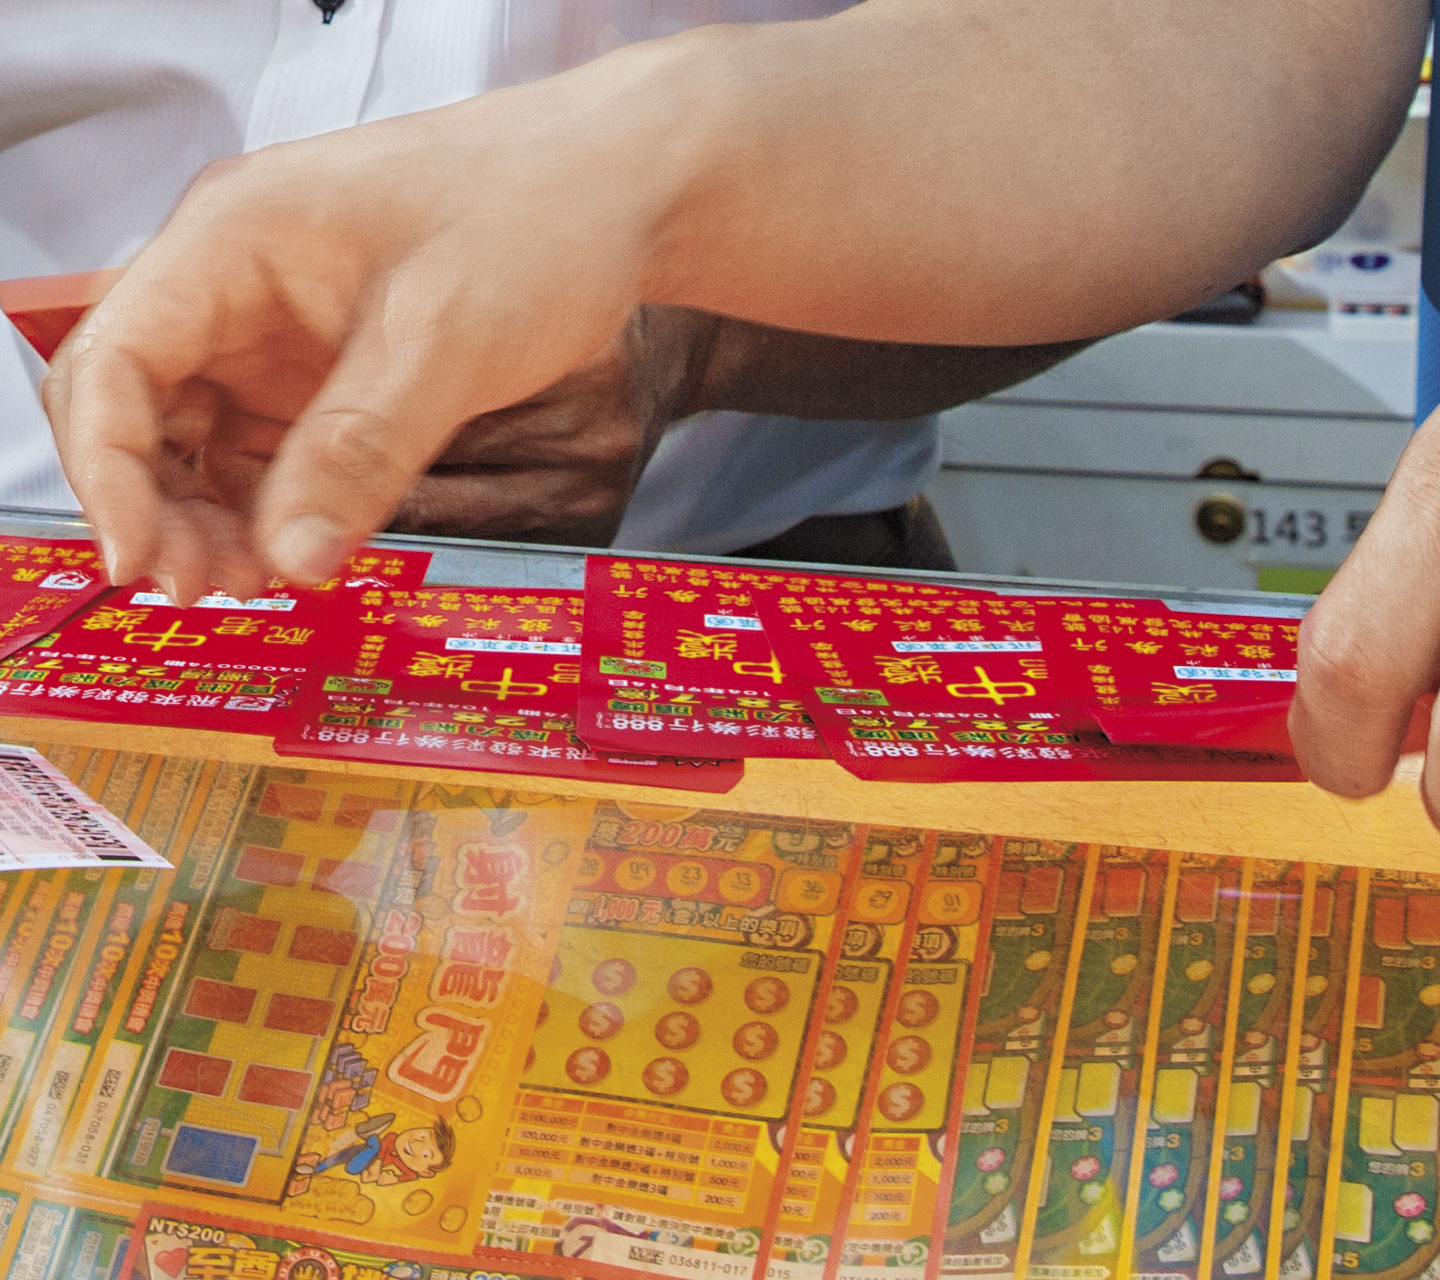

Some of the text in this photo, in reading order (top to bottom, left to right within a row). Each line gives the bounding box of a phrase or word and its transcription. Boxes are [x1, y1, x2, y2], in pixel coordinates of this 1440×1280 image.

[1252, 509, 1327, 547] 143
[81, 605, 315, 652] 祝君中獎
[388, 838, 530, 1103] 射龍門
[148, 1216, 226, 1245] NT$200
[668, 1252, 750, 1277] 036811-017
